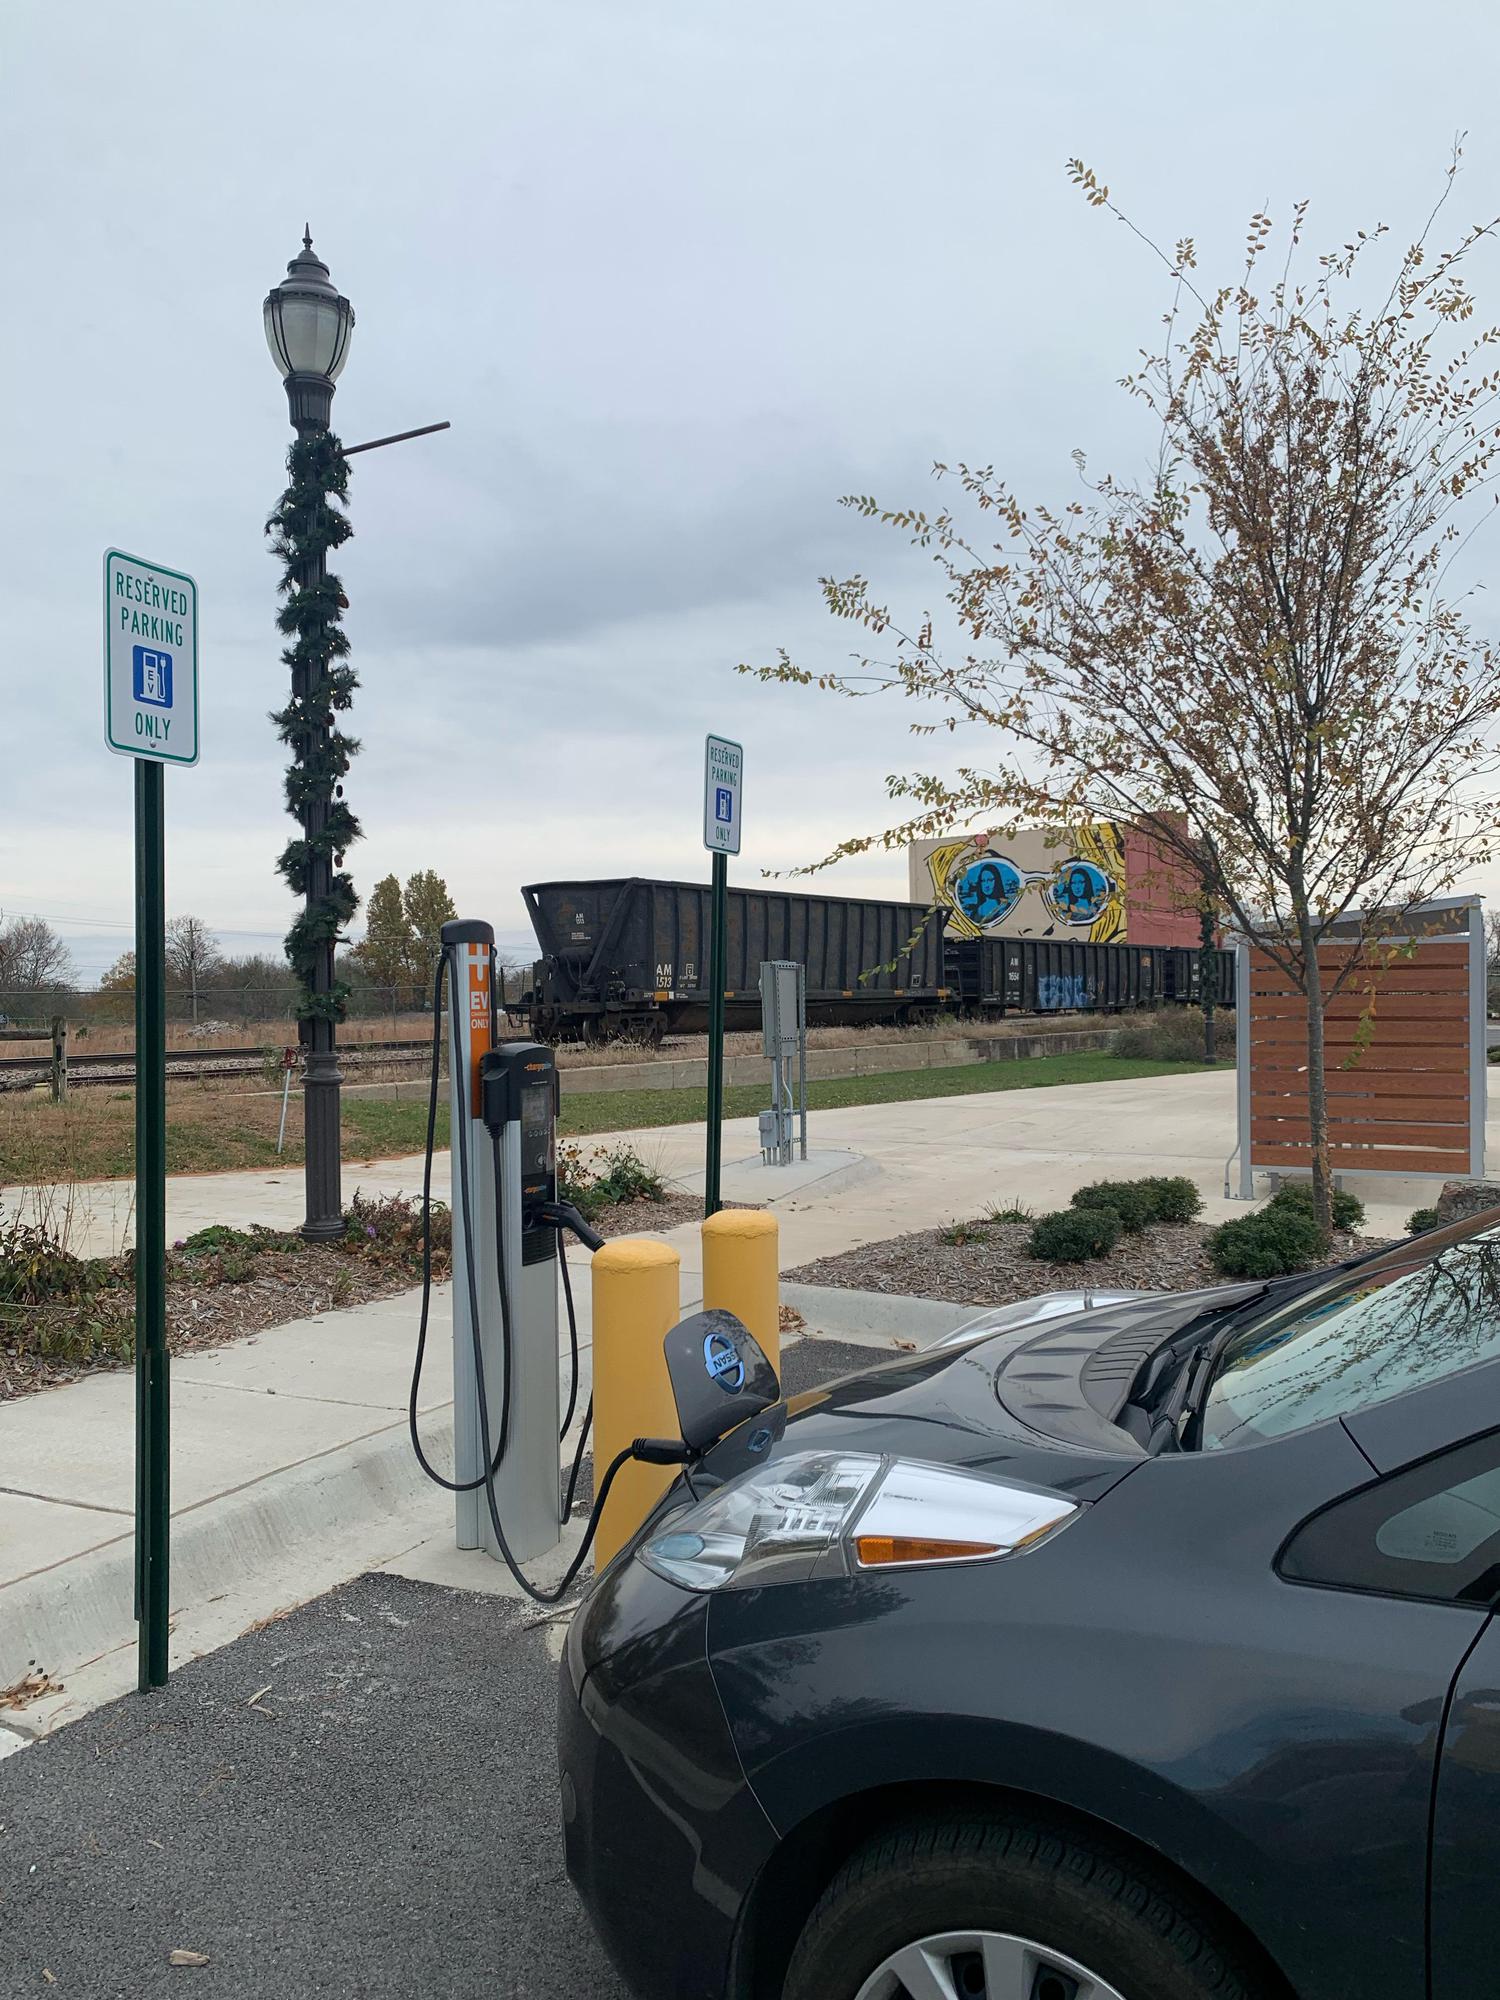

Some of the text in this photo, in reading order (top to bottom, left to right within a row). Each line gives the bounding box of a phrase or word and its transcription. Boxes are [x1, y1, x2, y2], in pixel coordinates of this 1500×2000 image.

[116, 571, 188, 617] RESERVED
[121, 606, 183, 647] PARKING
[135, 711, 171, 741] ONLY
[710, 746, 740, 769] RESERVED
[711, 766, 737, 787] PARKING
[715, 825, 731, 842] ONLY
[656, 963, 672, 976] AM
[656, 976, 672, 988] 1513
[470, 991, 489, 1010] EV
[471, 1018, 489, 1029] ONLY
